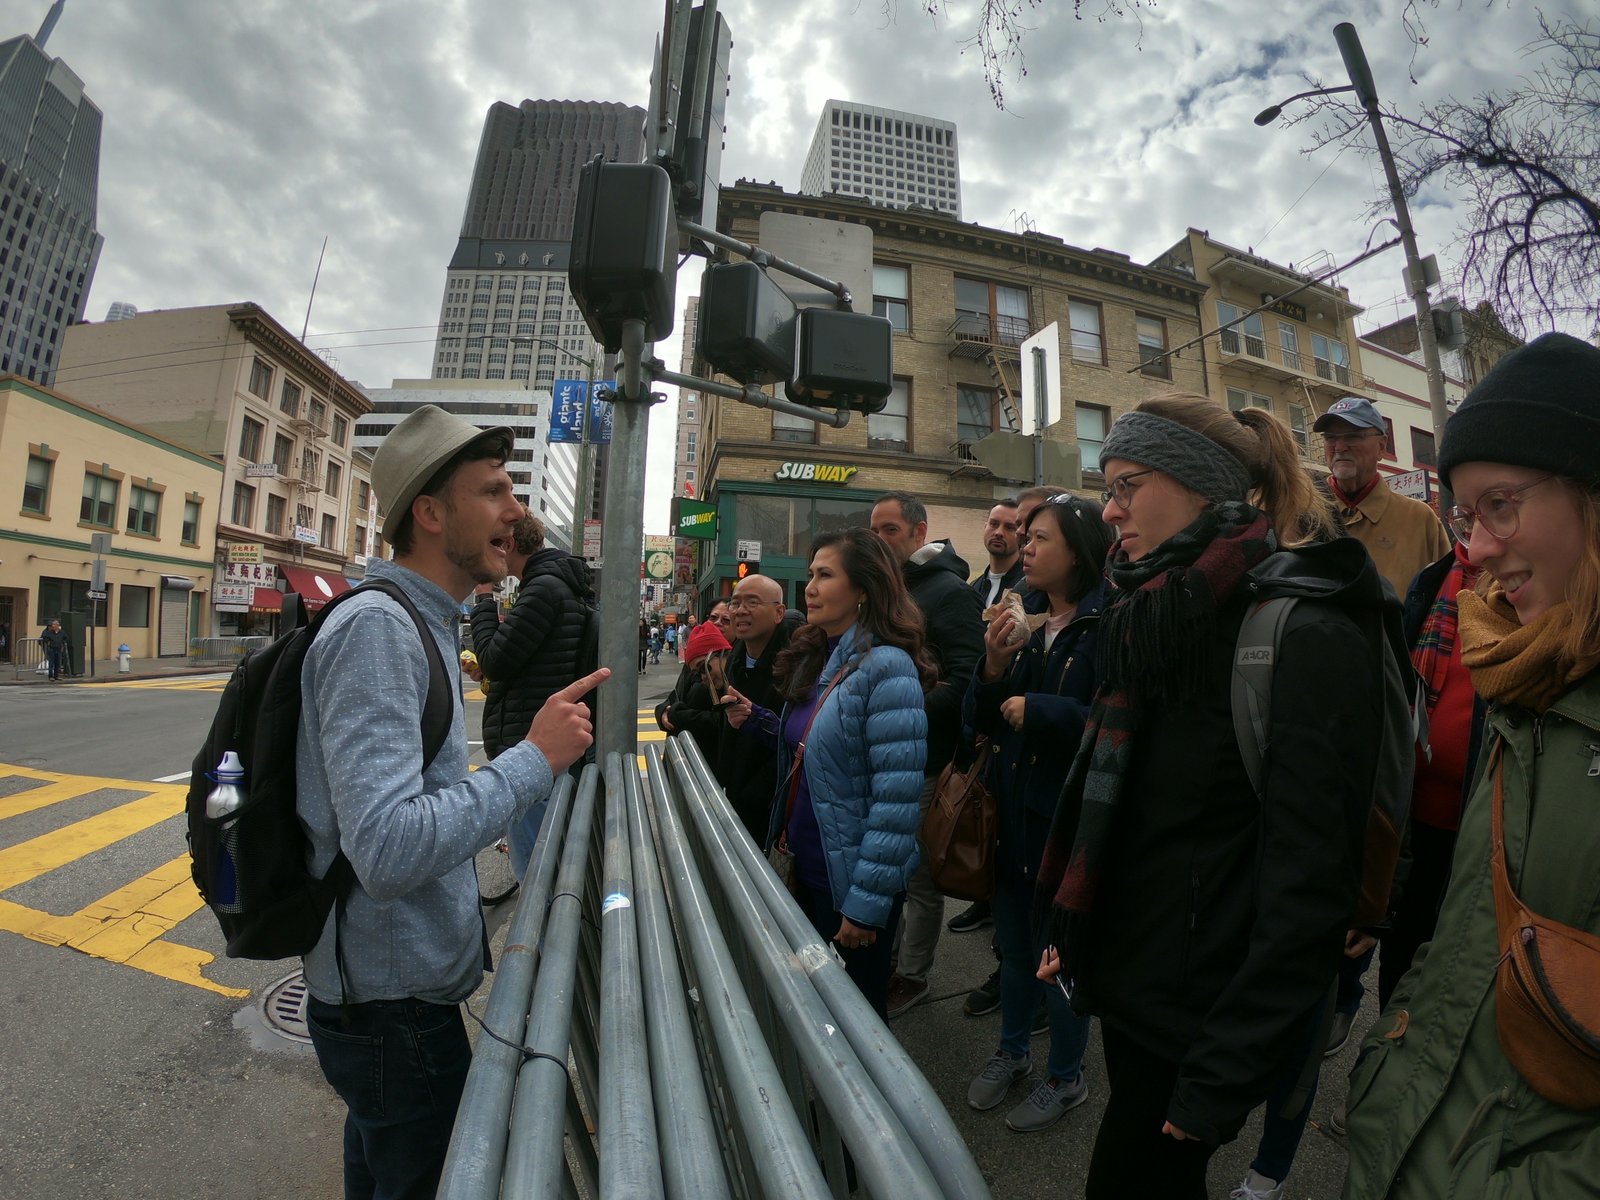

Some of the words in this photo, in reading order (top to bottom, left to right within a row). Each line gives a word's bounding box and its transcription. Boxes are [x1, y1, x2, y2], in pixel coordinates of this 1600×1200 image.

[570, 402, 584, 431] land
[776, 462, 857, 482] SUBWAY
[680, 511, 716, 528] SUBWAY
